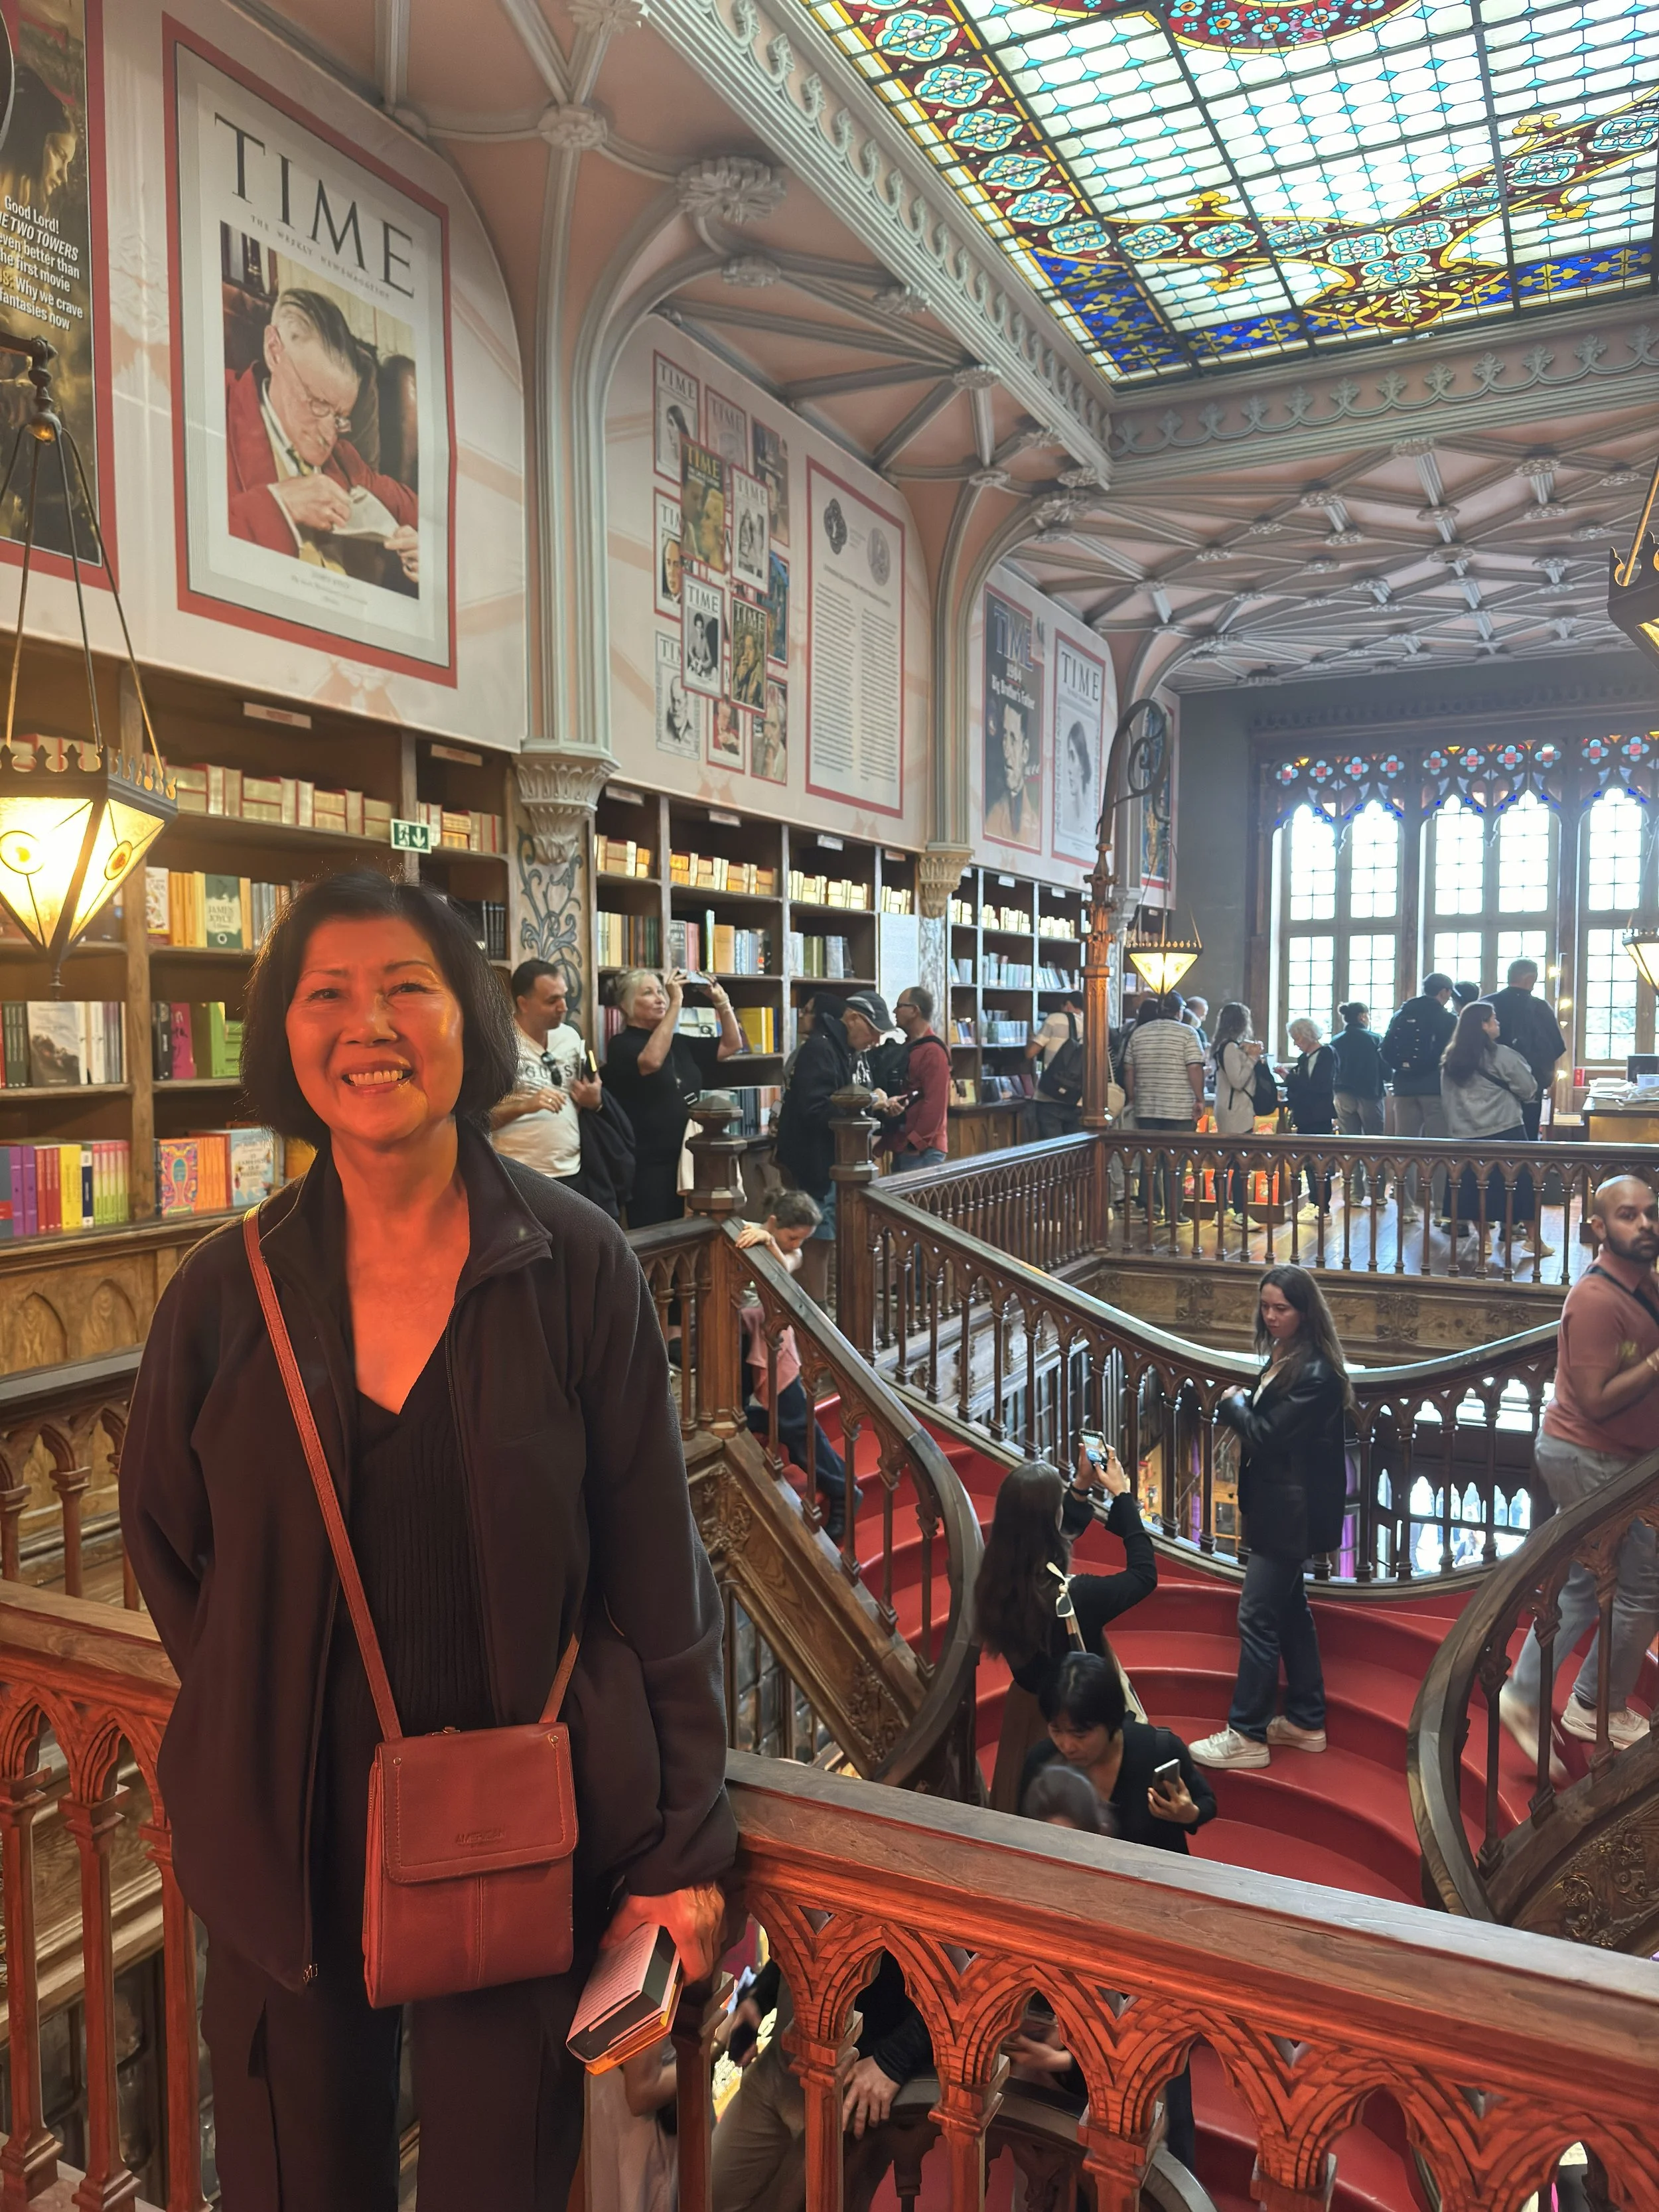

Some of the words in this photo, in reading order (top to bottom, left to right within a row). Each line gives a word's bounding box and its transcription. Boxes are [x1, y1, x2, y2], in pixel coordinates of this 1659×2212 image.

[4, 194, 31, 220] Good
[33, 208, 60, 235] Lord!
[214, 111, 415, 299] TIME
[250, 214, 269, 232] THE
[10, 216, 35, 241] TWO
[36, 230, 80, 262] TOWERS
[15, 254, 38, 279] first
[40, 269, 71, 293] movie
[23, 239, 56, 268] better
[57, 258, 80, 280] than
[0, 286, 48, 322] fantasies
[49, 314, 71, 332] now
[15, 275, 38, 302] Why
[39, 289, 55, 307] we
[56, 297, 84, 320] crave
[660, 362, 695, 400] TIME
[711, 397, 744, 434] TIME
[687, 445, 721, 479] TIME
[736, 475, 767, 506] TIME
[661, 503, 680, 530] TI
[687, 583, 719, 614] TIME
[735, 603, 765, 632] TIME
[660, 638, 681, 662] TI
[993, 603, 1035, 672] TIME
[1060, 650, 1100, 702] TIME
[525, 1063, 579, 1079] GUS
